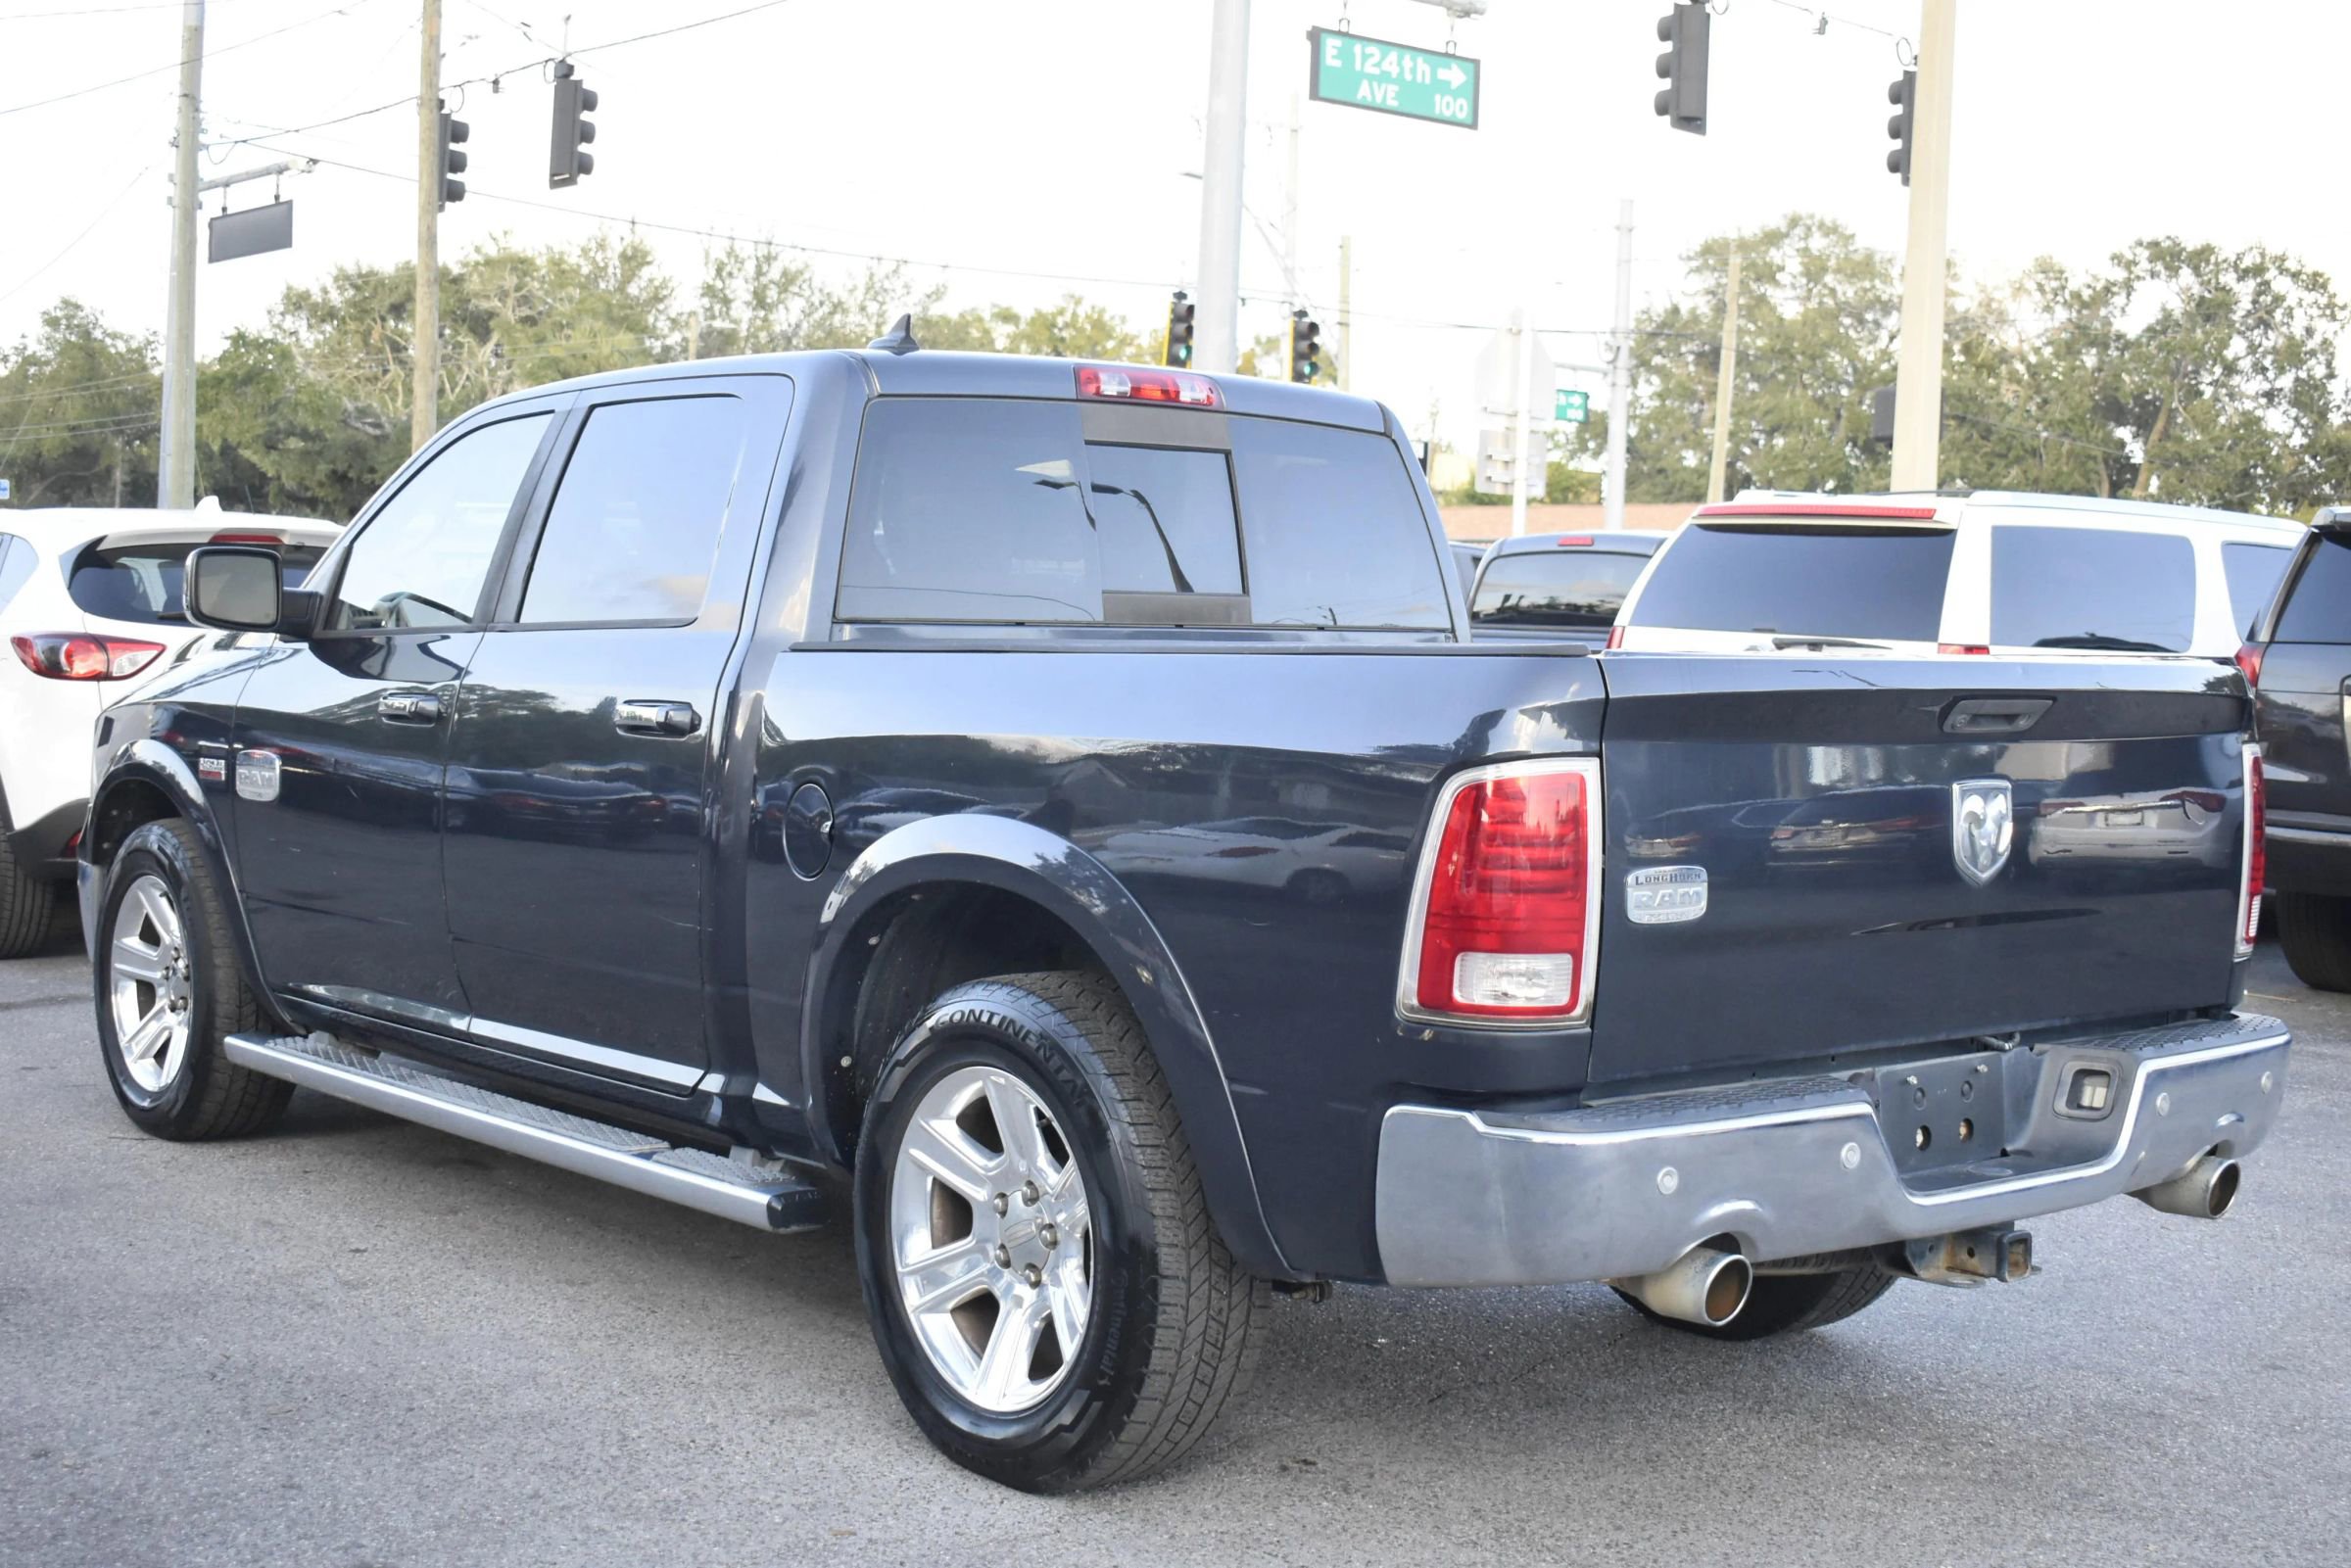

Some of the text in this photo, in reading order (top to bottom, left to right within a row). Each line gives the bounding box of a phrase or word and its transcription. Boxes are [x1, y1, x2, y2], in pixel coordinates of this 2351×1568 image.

[1324, 38, 1431, 85] E 124th
[1356, 78, 1468, 119] AVE 100
[1632, 886, 1703, 909] RAM
